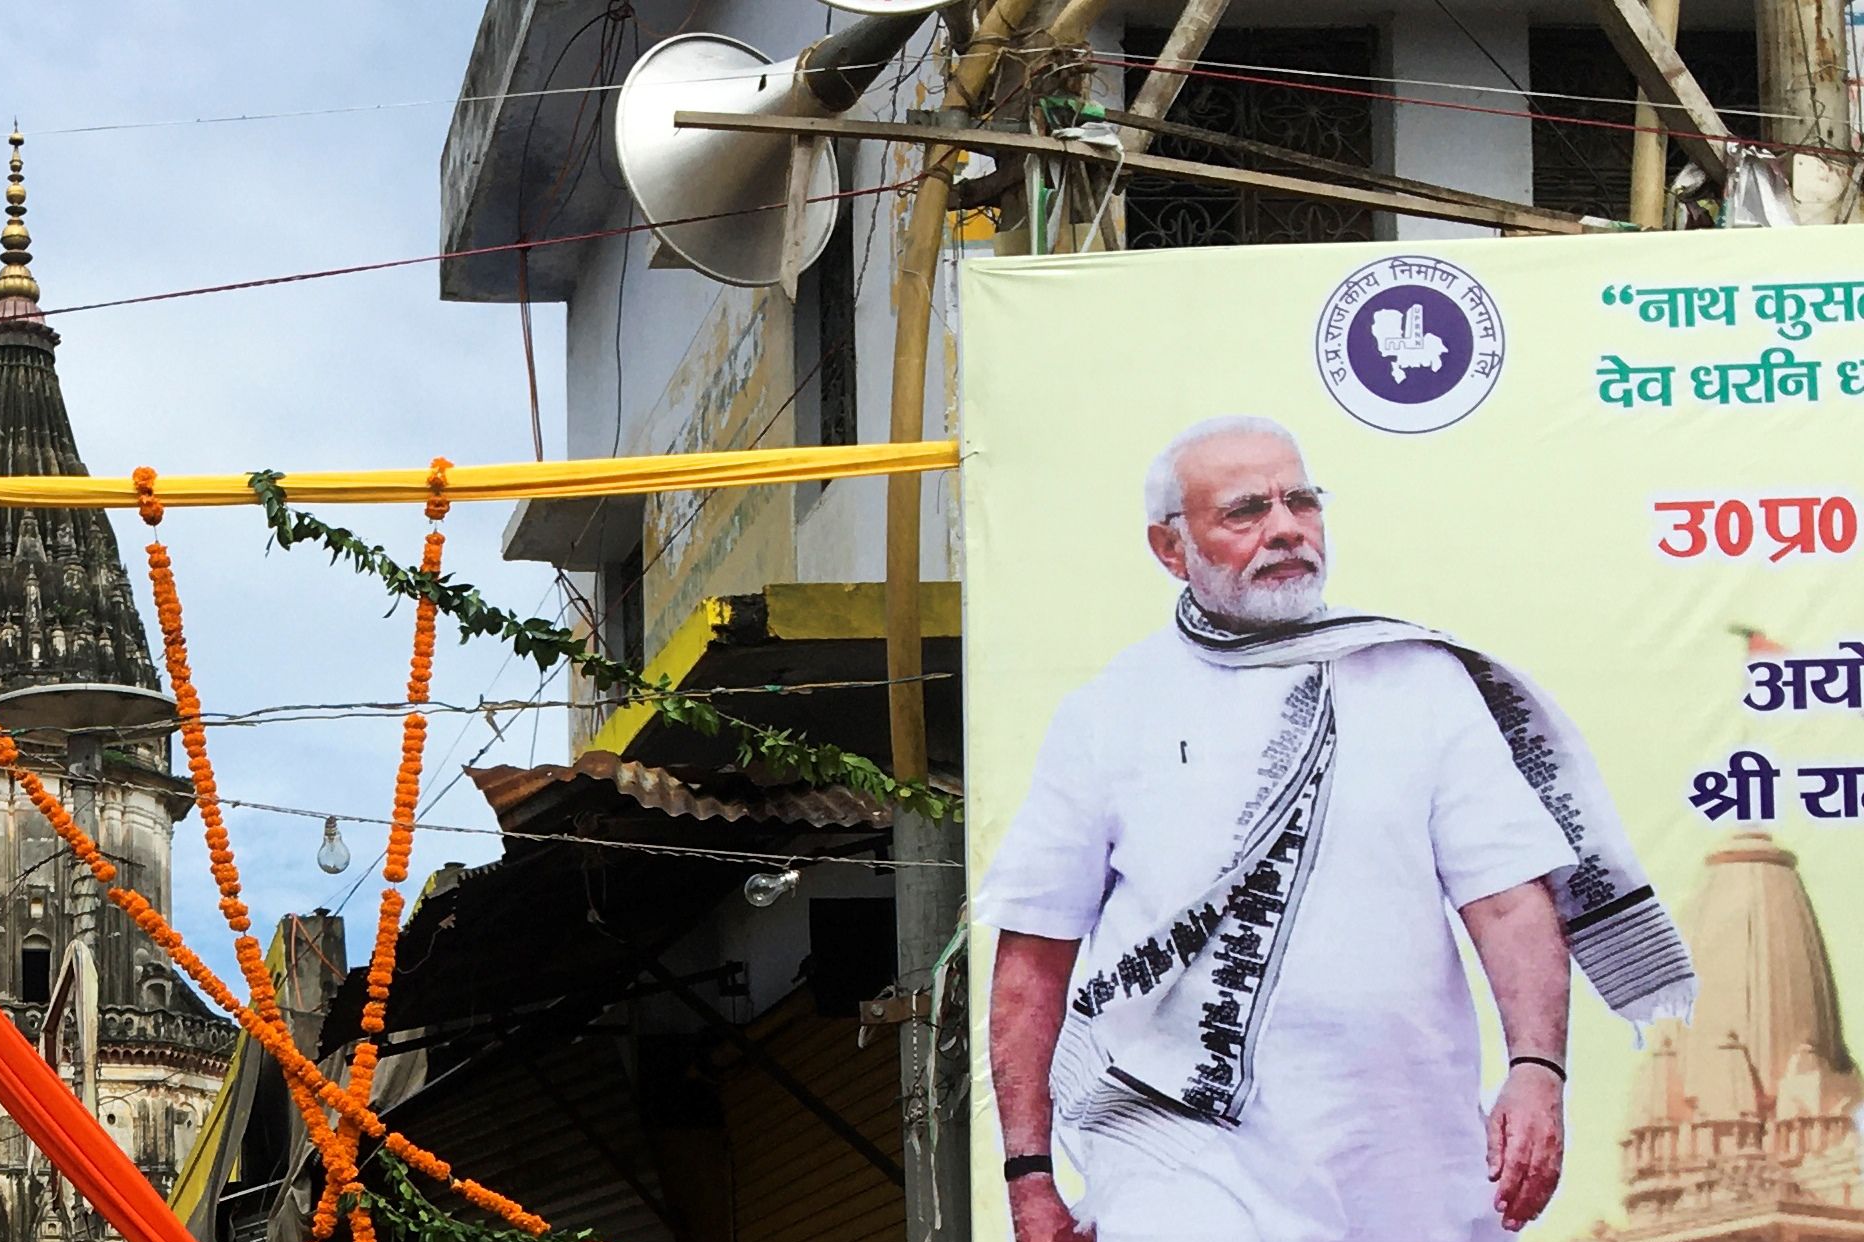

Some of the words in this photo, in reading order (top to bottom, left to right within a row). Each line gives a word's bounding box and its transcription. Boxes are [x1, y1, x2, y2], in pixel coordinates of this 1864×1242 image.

[1460, 285, 1497, 342] निगम
[1752, 281, 1864, 341] कुस
[1596, 355, 1676, 408] देव
[1690, 347, 1822, 404] धरनि
[1688, 750, 1781, 822] श्री
[1797, 766, 1864, 819] रा
